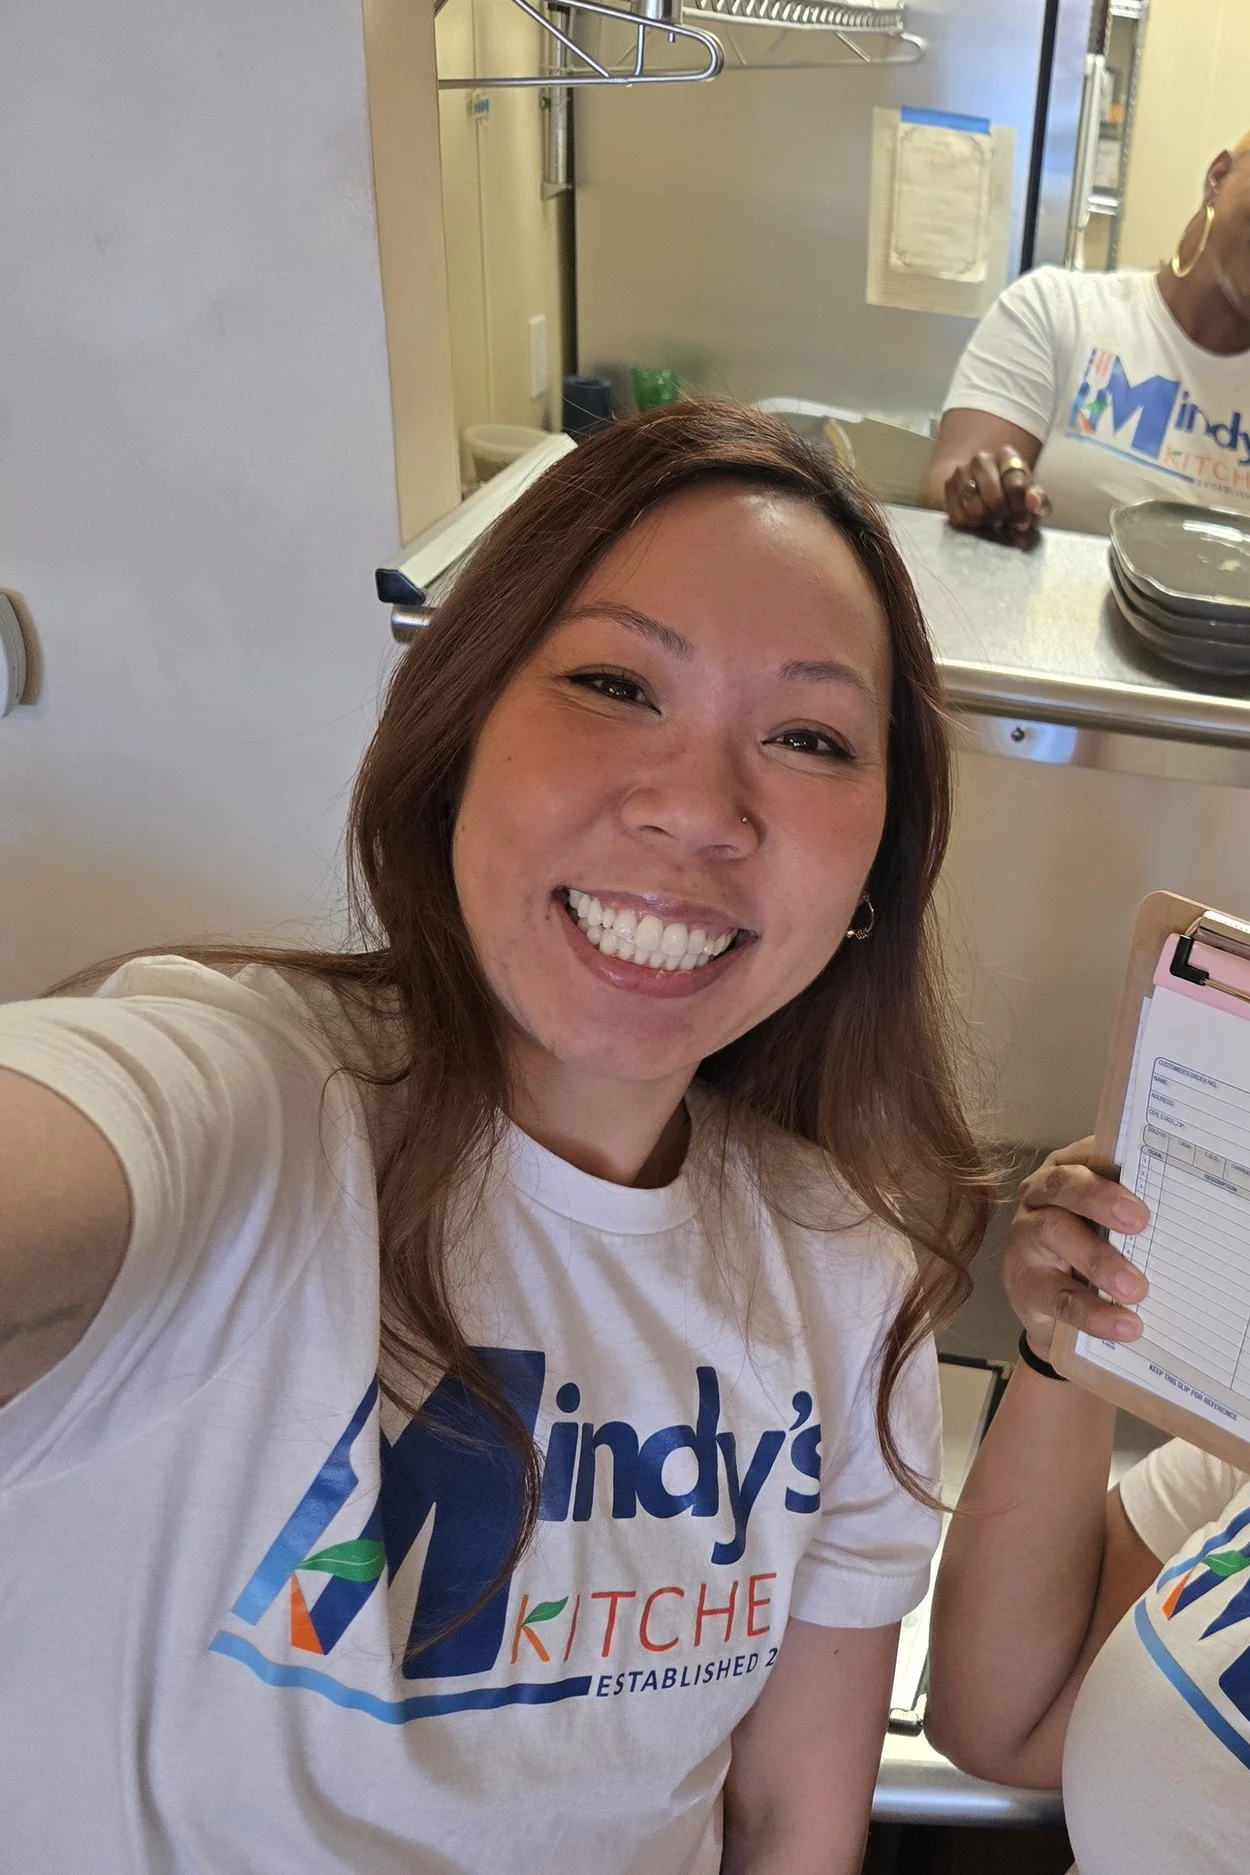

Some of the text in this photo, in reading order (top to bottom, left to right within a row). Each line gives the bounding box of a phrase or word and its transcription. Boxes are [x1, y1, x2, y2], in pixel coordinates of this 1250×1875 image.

[1149, 1363, 1238, 1422] KEEP THIS SLIP FOR REFERENCE
[231, 1346, 822, 1679] Mindy's
[510, 1573, 777, 1665] KITCHE
[596, 1647, 779, 1698] ESTABLISHED 2
